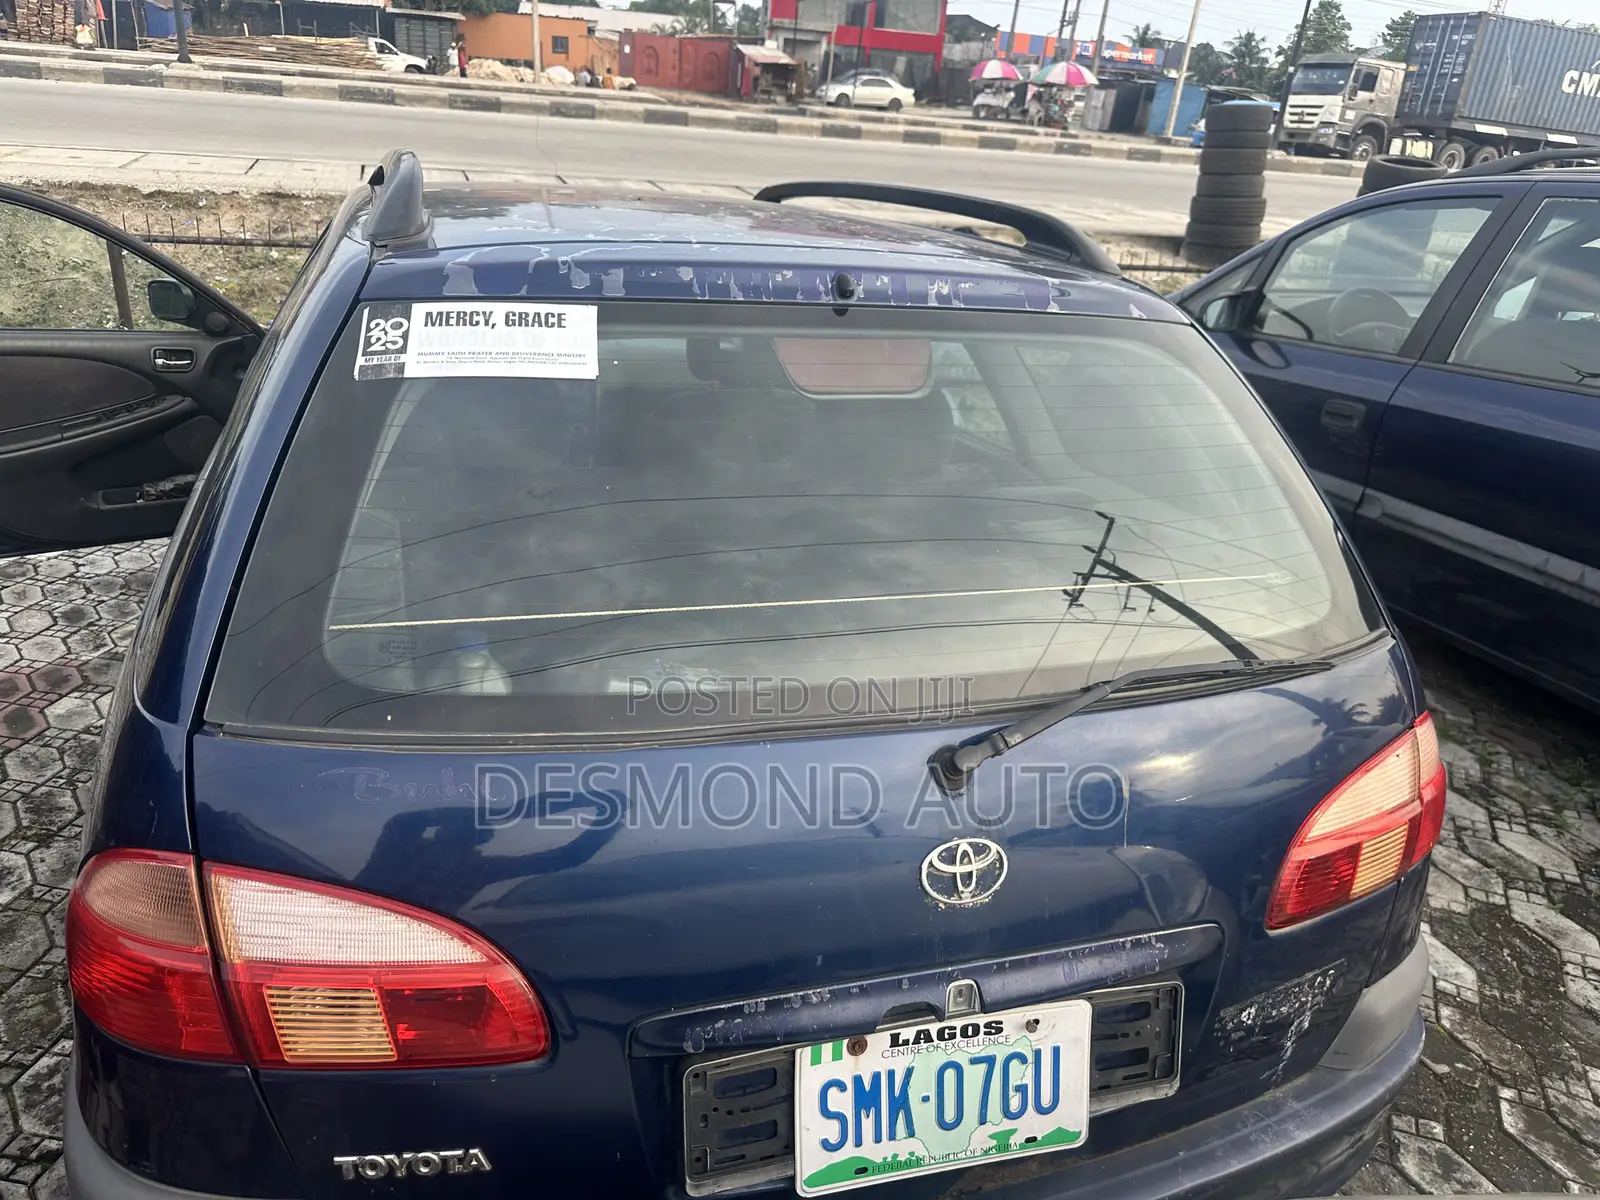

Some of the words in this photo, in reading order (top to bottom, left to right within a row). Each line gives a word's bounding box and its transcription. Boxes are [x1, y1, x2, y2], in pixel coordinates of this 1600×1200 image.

[1561, 69, 1600, 98] CM
[423, 310, 497, 329] MERCY,
[504, 311, 567, 329] GRACE
[881, 1047, 924, 1060] CENTRE
[926, 1044, 943, 1054] OF
[944, 1034, 1011, 1051] EXCELLENCE
[889, 1020, 1004, 1048] LAGOS
[333, 1147, 493, 1181] TOYOTA
[871, 1158, 915, 1175] FEDERAL
[916, 1150, 962, 1168] REPUBLIC
[962, 1148, 978, 1159] OF
[979, 1141, 1019, 1157] NIGERIA
